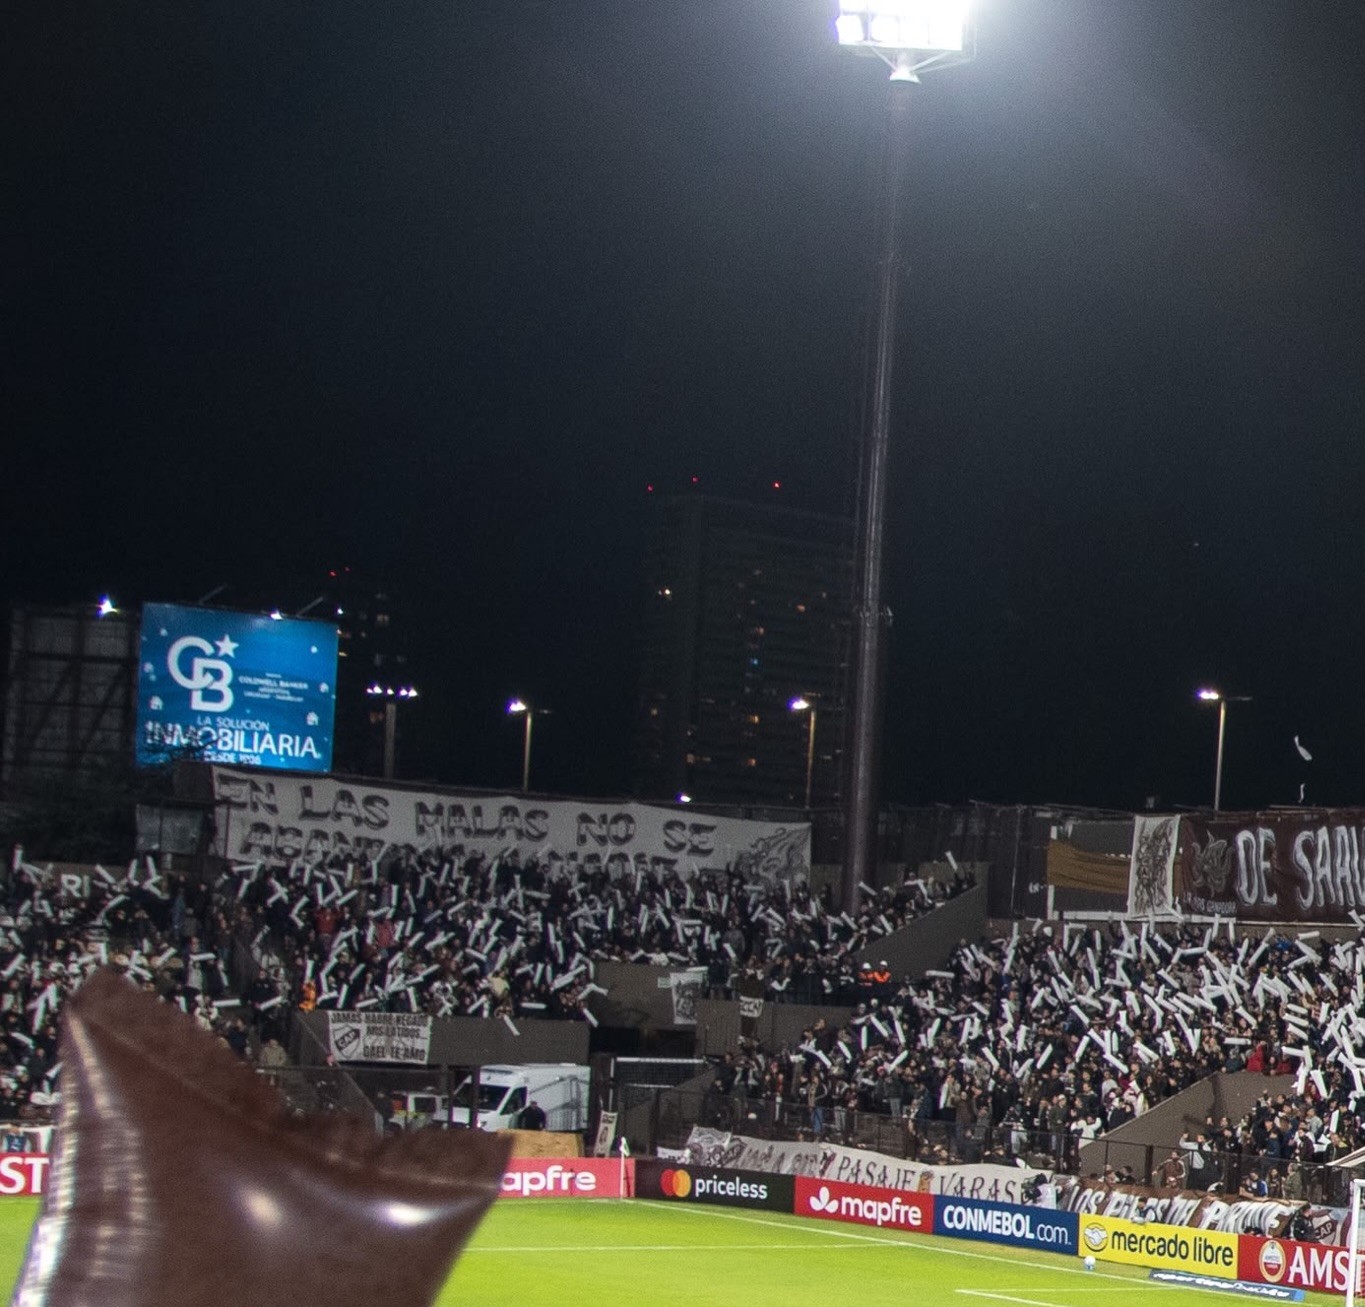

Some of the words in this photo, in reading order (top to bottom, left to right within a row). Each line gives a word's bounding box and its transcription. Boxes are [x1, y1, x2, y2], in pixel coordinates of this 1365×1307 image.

[299, 785, 389, 830] LAS
[415, 801, 549, 842] MALAS
[577, 812, 636, 846] NO
[663, 820, 717, 857] SE
[501, 1165, 597, 1193] apfre
[695, 1175, 768, 1200] priceless
[841, 1196, 922, 1226] mapfre
[943, 1205, 1069, 1244] CONMEBOL.com
[1112, 1230, 1189, 1260] mercado
[1193, 1237, 1234, 1267] libre
